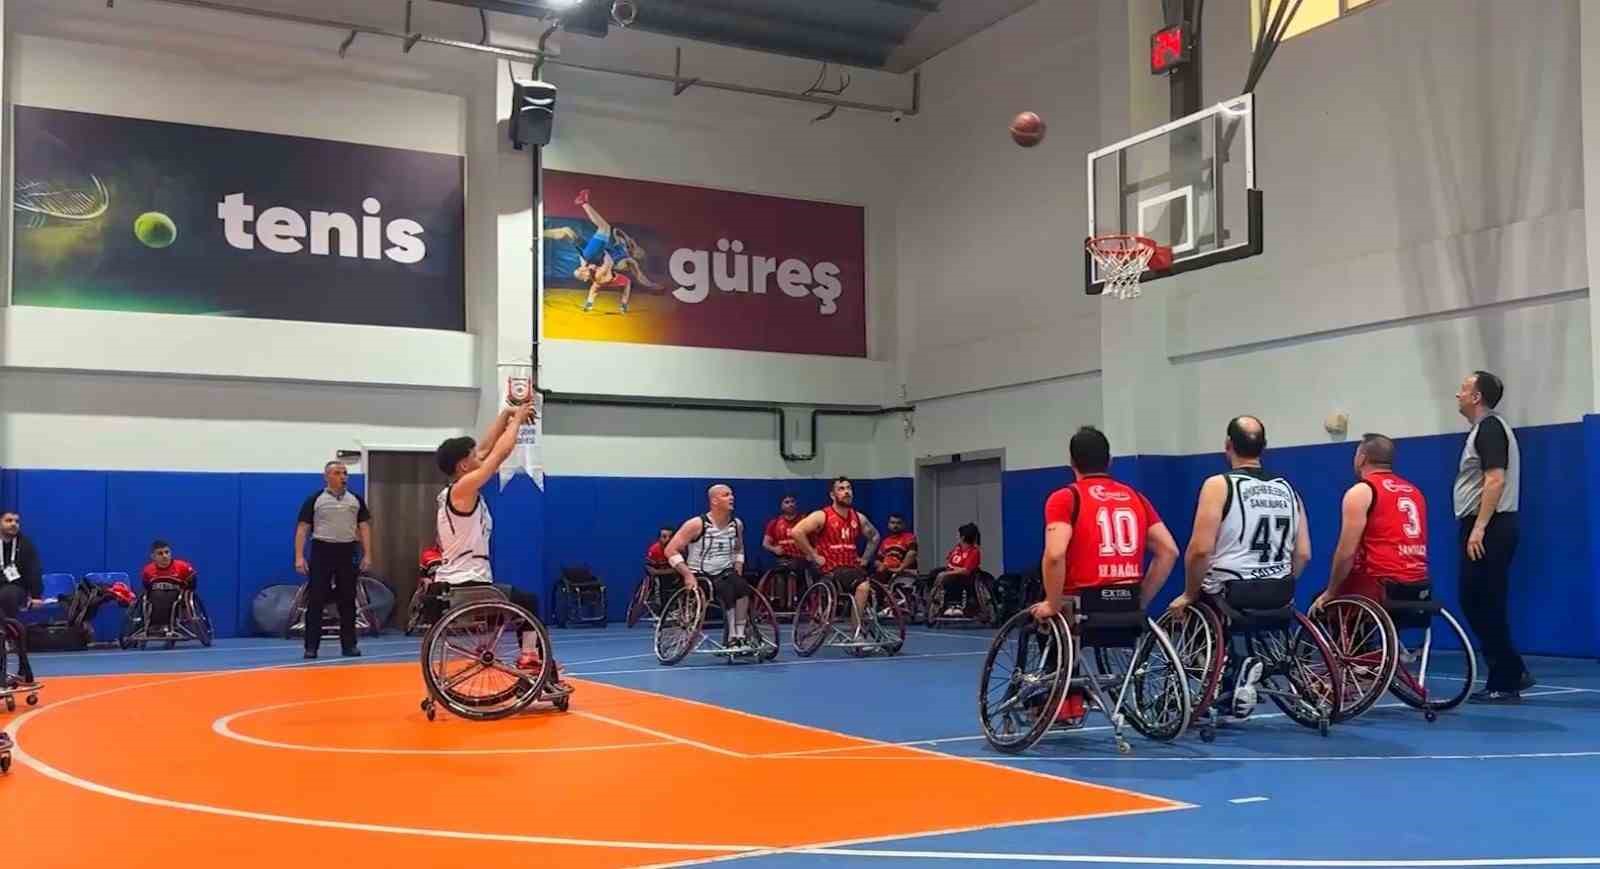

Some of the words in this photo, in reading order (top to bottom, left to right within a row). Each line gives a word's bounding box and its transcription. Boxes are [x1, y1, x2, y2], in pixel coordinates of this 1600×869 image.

[217, 192, 426, 264] tenis
[669, 237, 843, 315] güreş
[1096, 506, 1138, 557] 10
[1249, 515, 1291, 563] 47
[1396, 496, 1421, 539] 3
